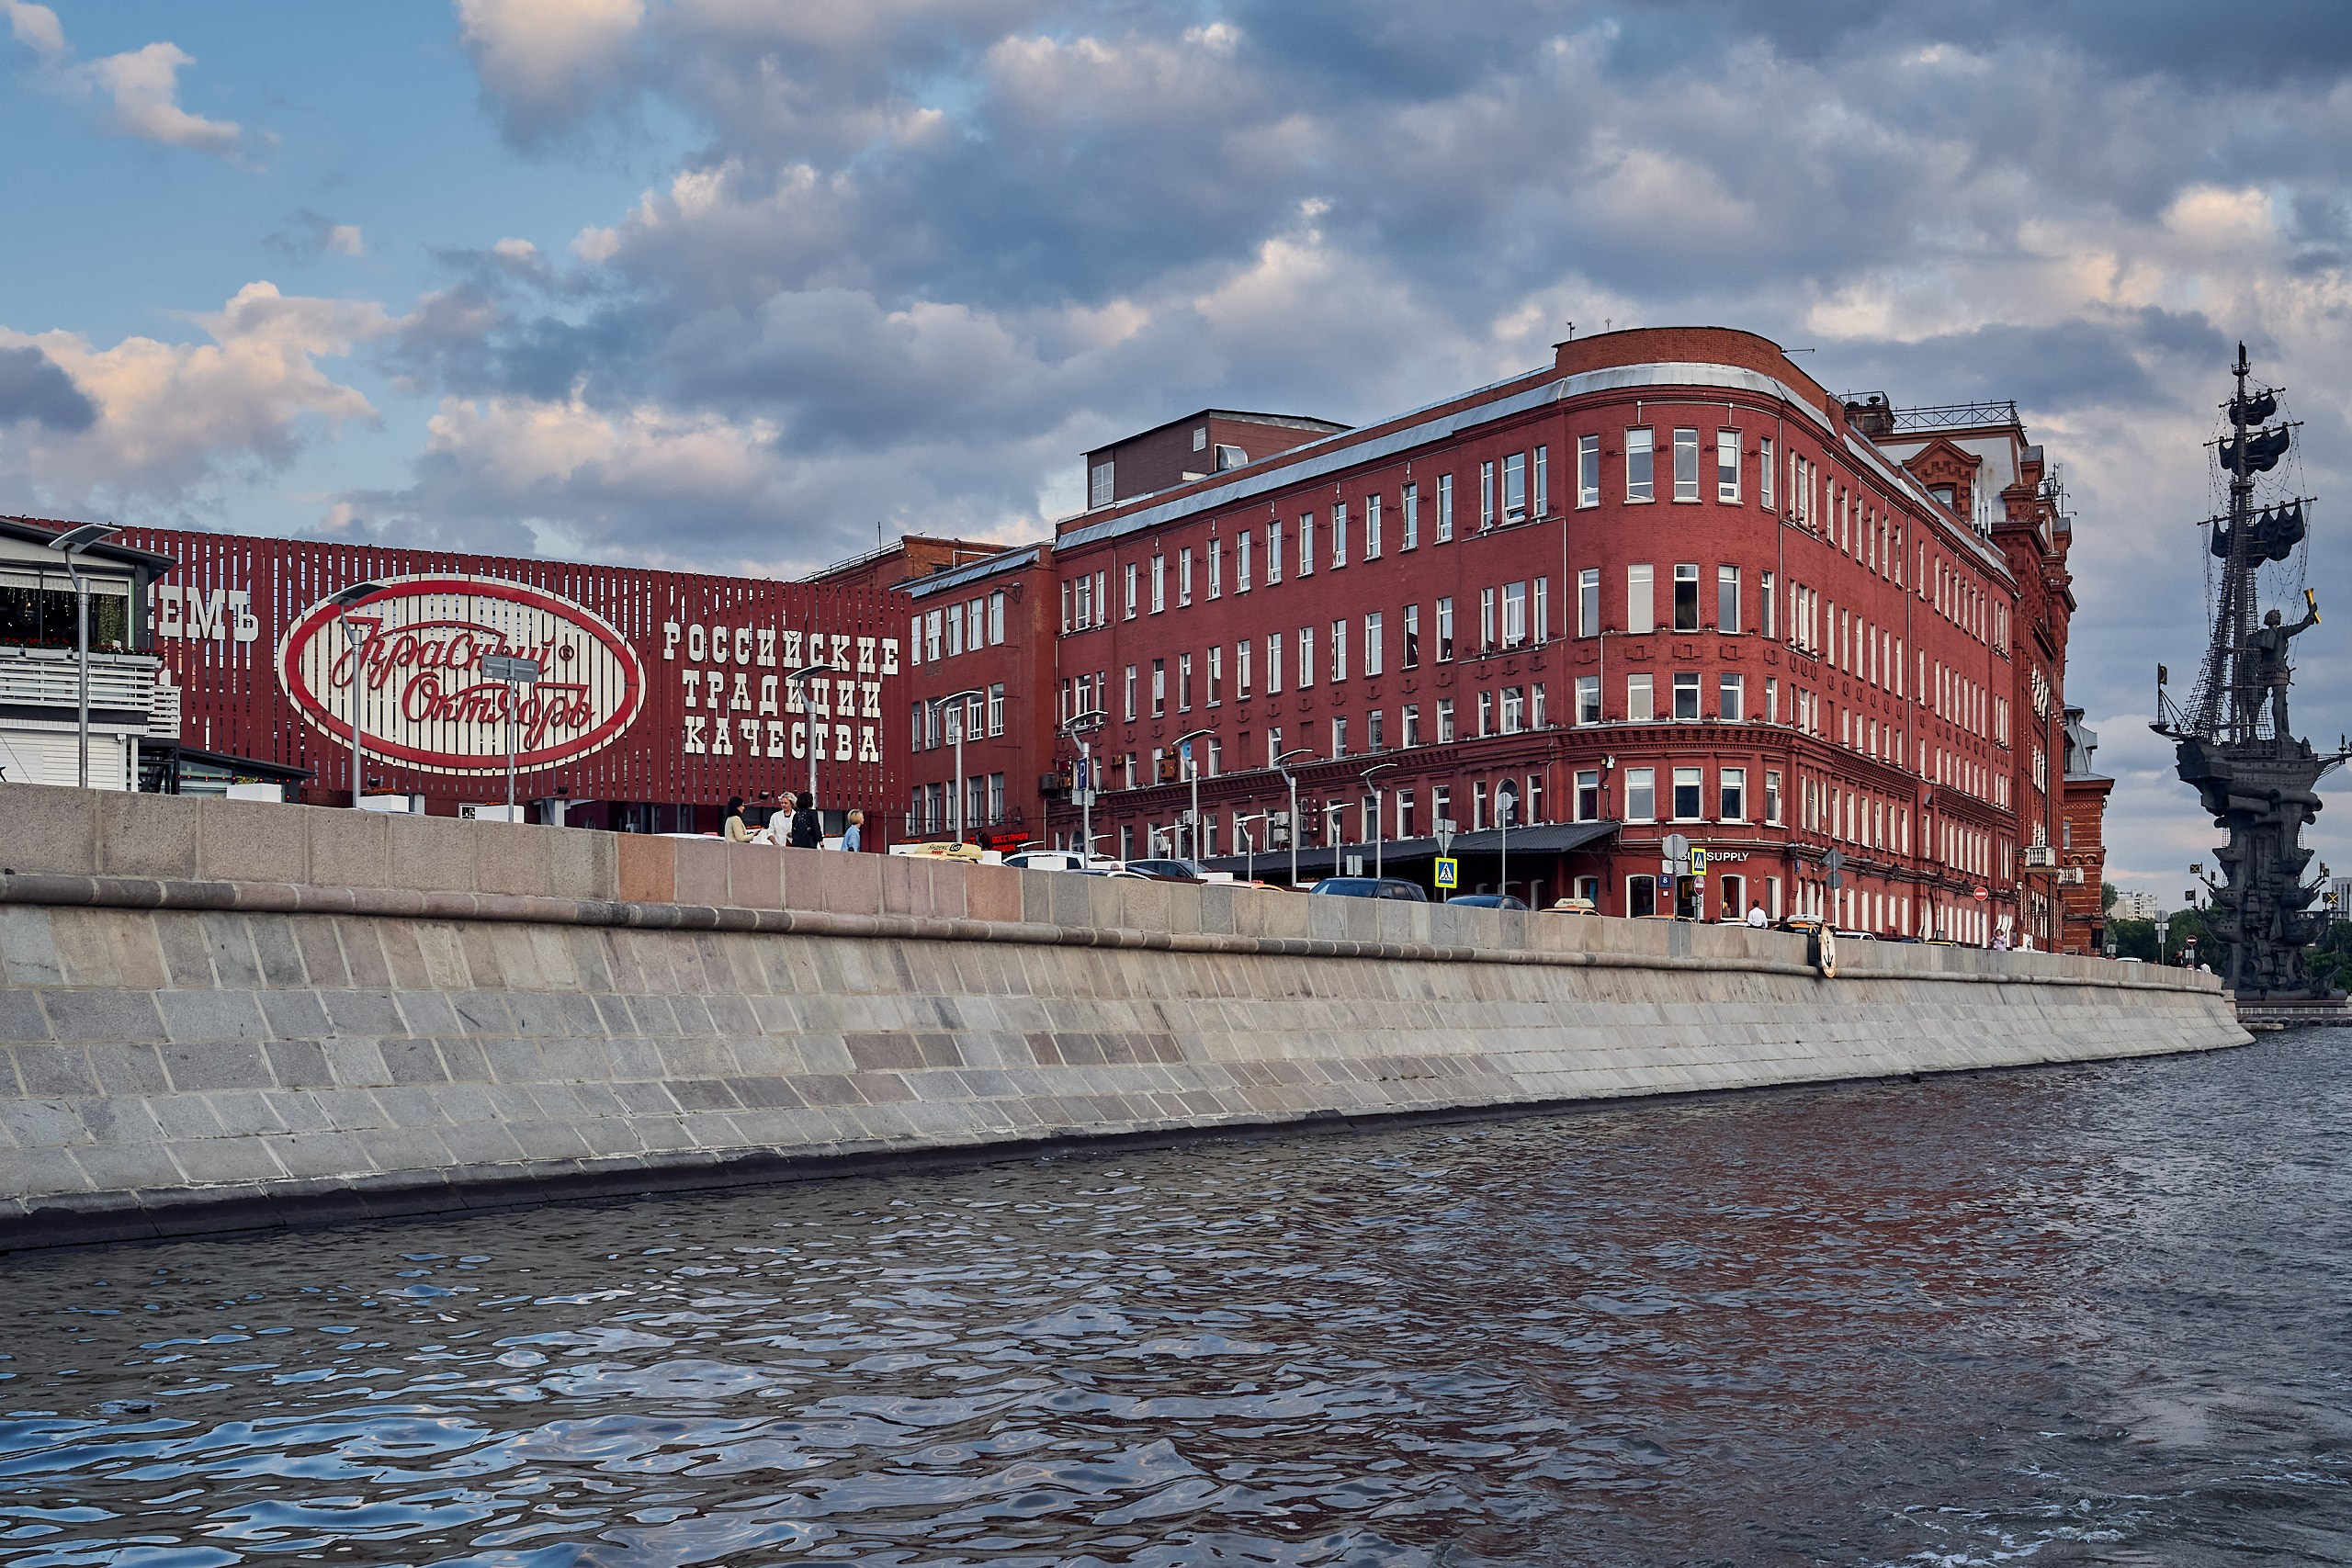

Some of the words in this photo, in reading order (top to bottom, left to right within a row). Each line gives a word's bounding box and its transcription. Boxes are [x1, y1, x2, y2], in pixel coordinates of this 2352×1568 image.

[148, 581, 259, 642] ЕМЪ
[663, 621, 899, 675] РОССИЙСКИЕ
[401, 671, 596, 750] Октябрь
[682, 669, 881, 719] ТРАДИЦИИ
[684, 716, 879, 761] КАЧЕСТВА
[1080, 761, 1086, 786] P
